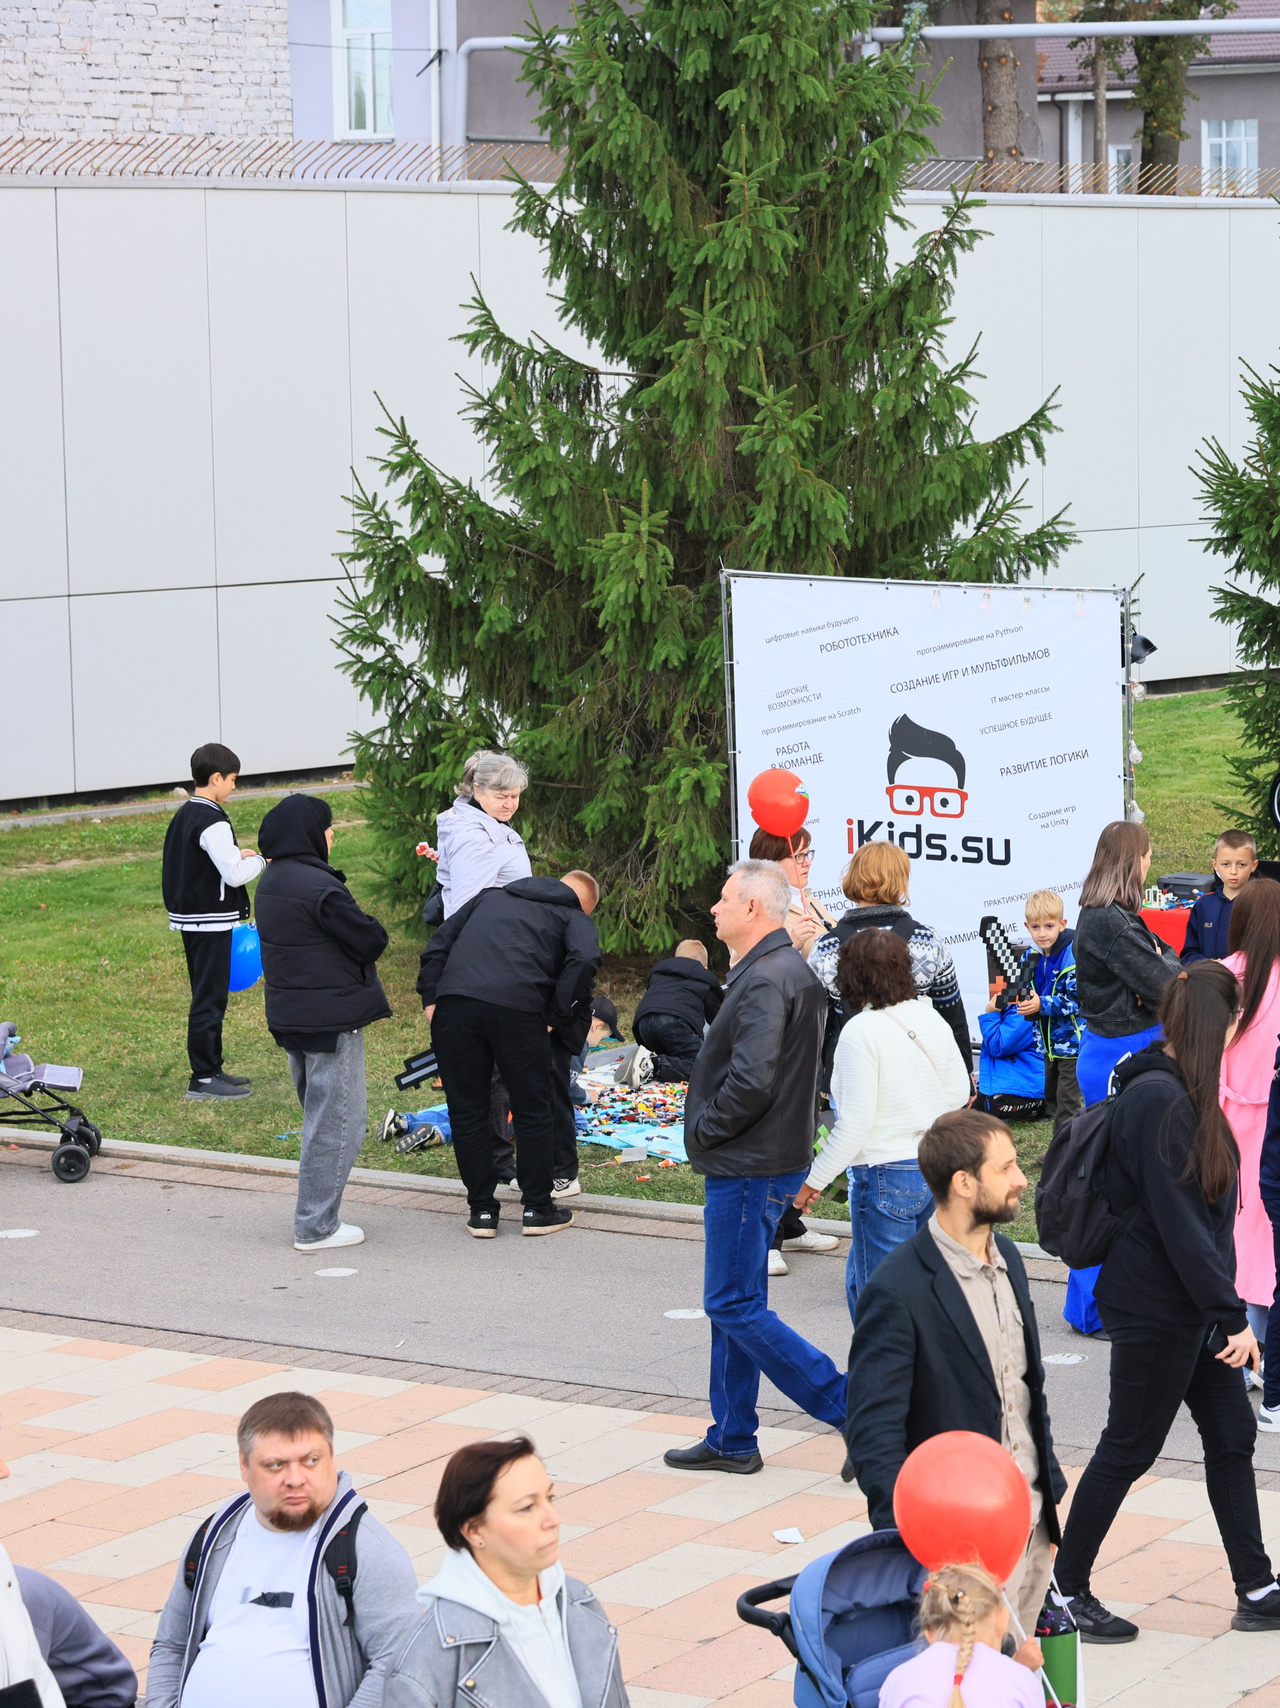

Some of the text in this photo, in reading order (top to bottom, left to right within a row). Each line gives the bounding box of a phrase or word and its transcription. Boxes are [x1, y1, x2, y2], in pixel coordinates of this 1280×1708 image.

[765, 615, 859, 644] цифровые навыки будущего
[819, 627, 900, 653] РОБОТОТЕХНИКА
[916, 625, 1024, 656] программирование на Pythvon
[890, 648, 1051, 694] СОЗДАНИЕ ИГР И МУЛЬТФИЛЬМОВ
[768, 692, 822, 712] ВОЗМОЖНОСТИ
[775, 684, 809, 699] ШИРОКИЕ
[990, 686, 1051, 704] IT мастер-классы
[761, 715, 827, 736] программирование
[837, 706, 862, 718] Scratch
[979, 712, 1053, 735] УСПЕШНОЕ БУДУЩЕЕ
[776, 741, 811, 756] РАБОТА
[779, 752, 825, 770] КОМАНДЕ
[999, 749, 1089, 777] РАЗВИТИЕ ЛОГИКИ
[1028, 805, 1077, 821] Создание игр
[1050, 818, 1069, 829] Unity
